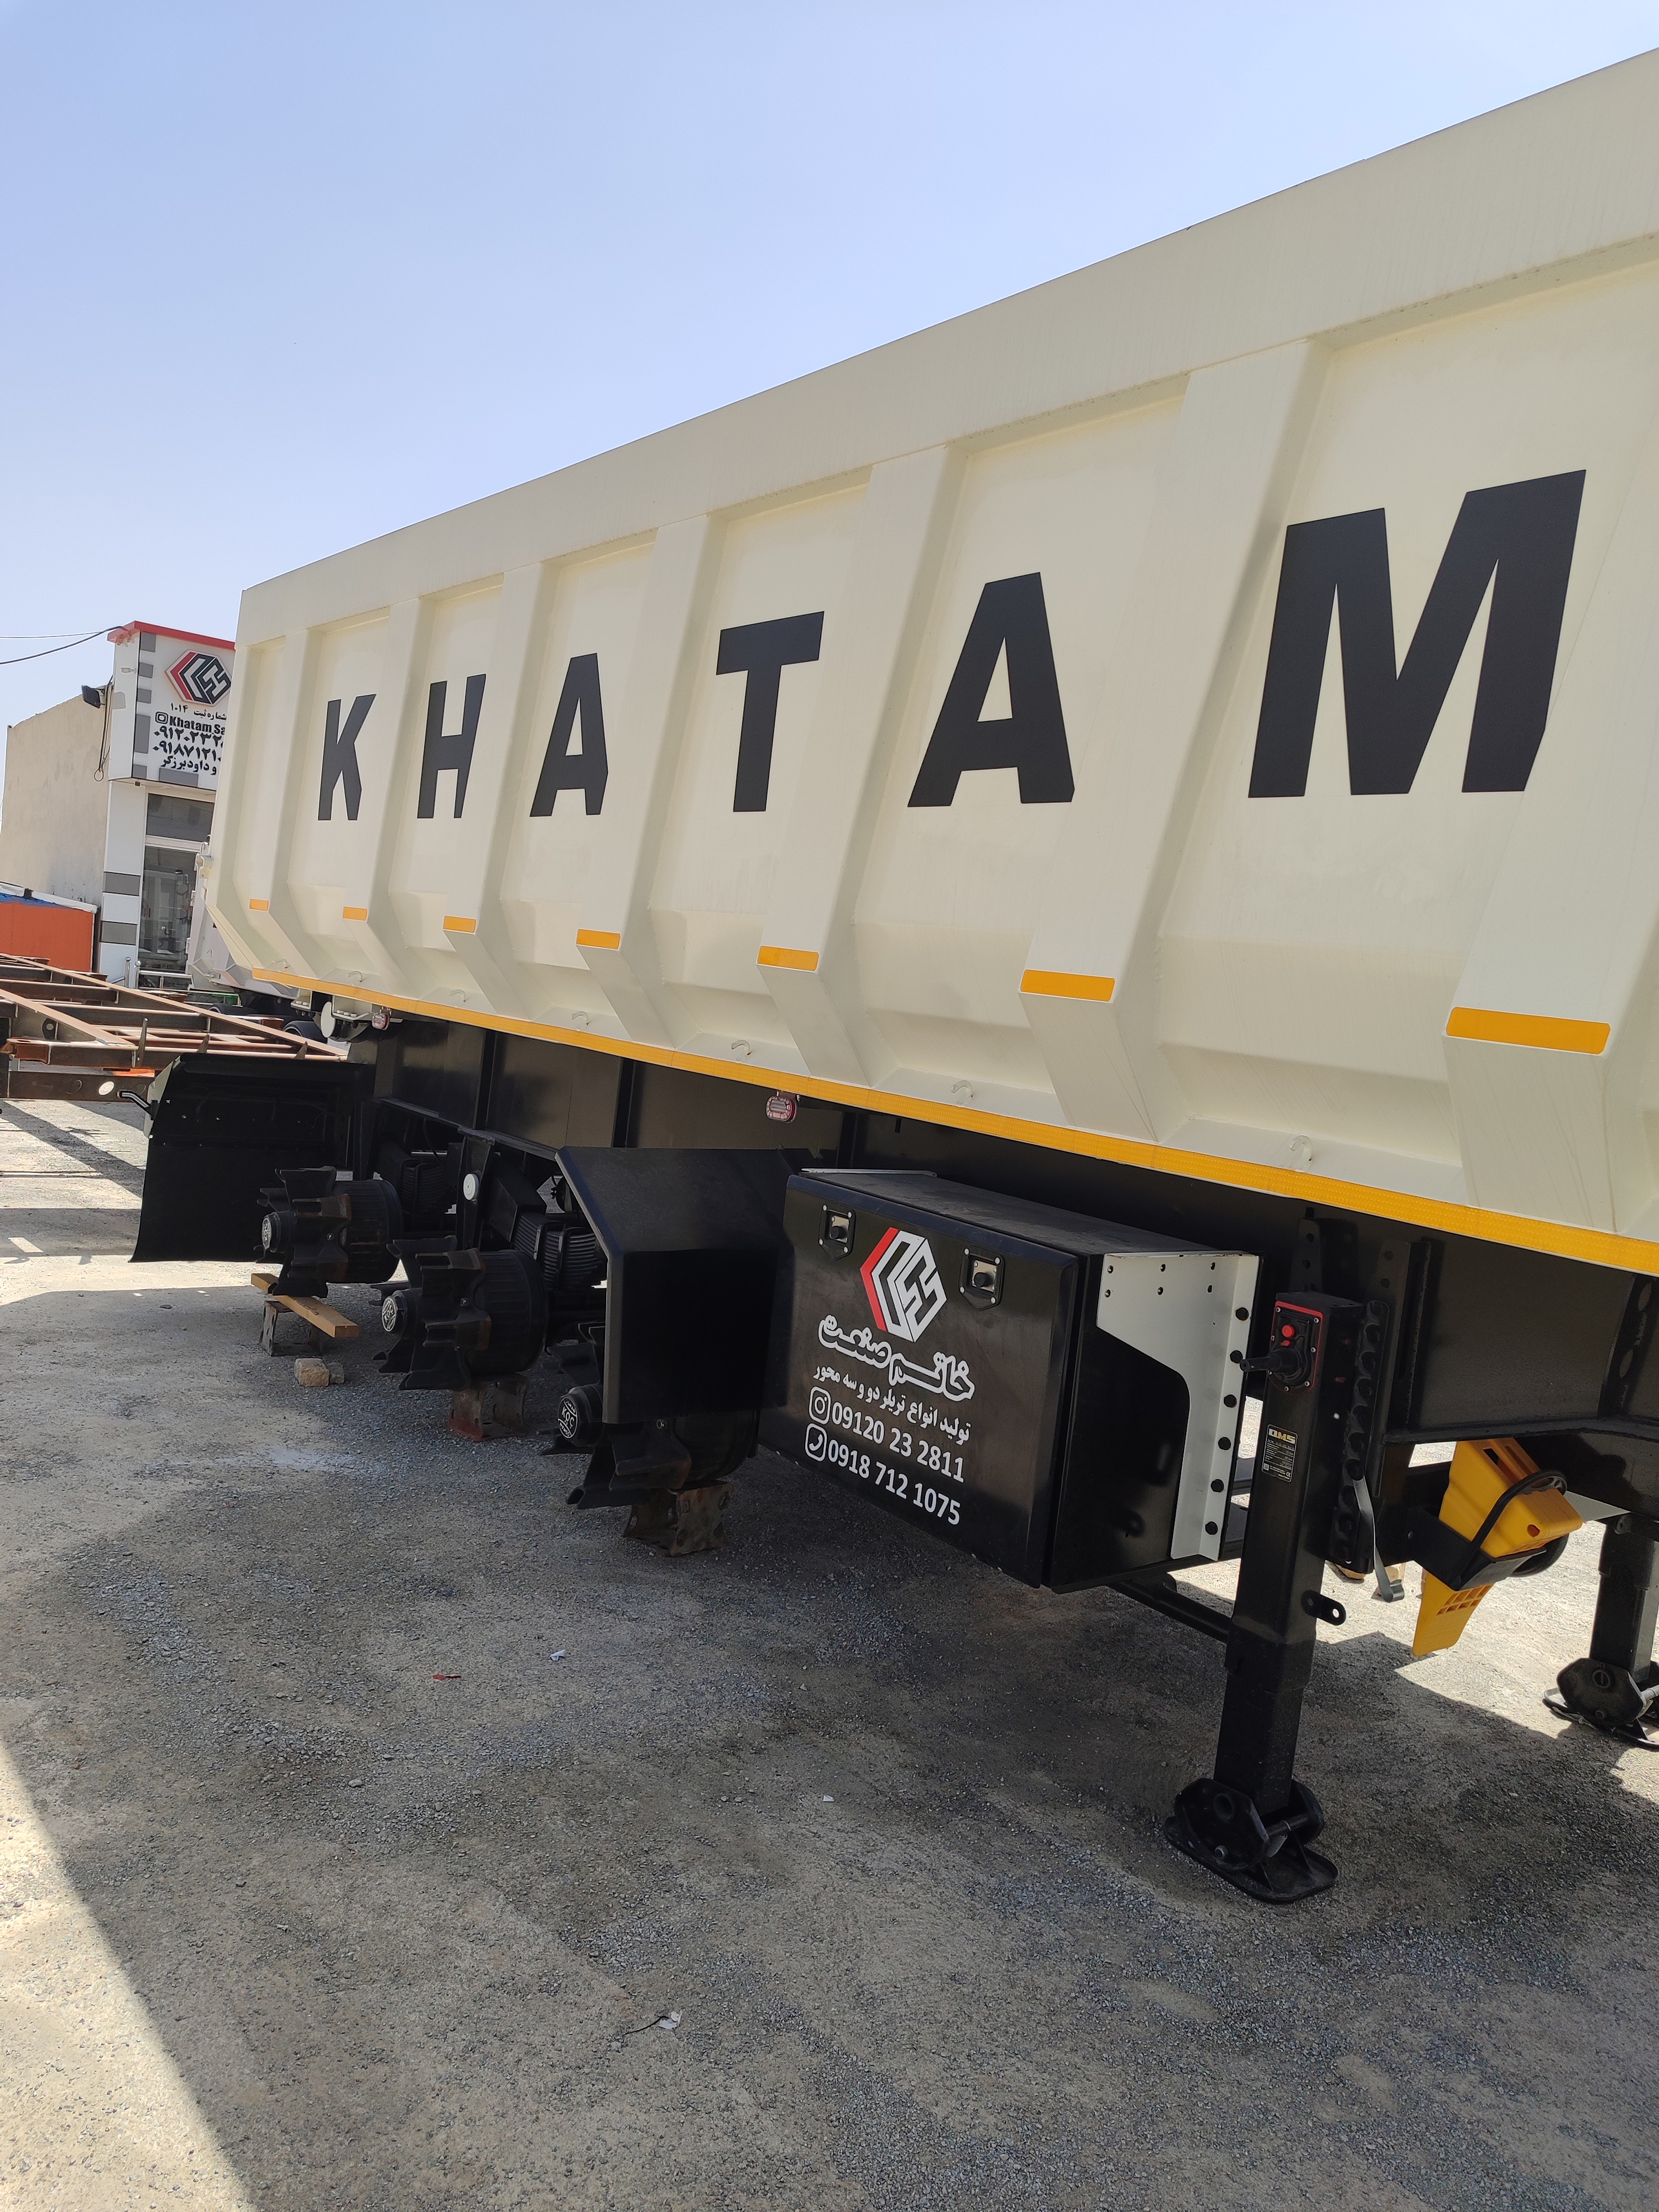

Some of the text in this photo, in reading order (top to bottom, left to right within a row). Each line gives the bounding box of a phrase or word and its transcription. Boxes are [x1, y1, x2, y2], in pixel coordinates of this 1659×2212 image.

[317, 469, 1586, 821] KHATAM
[194, 708, 207, 719] ثبت
[818, 1315, 975, 1401] خاتم صنعت
[813, 1366, 972, 1446] تولید انواع تریلر دو و سه محور
[831, 1401, 964, 1483] 09120 23 2811
[828, 1439, 961, 1525] 0918 712 1075
